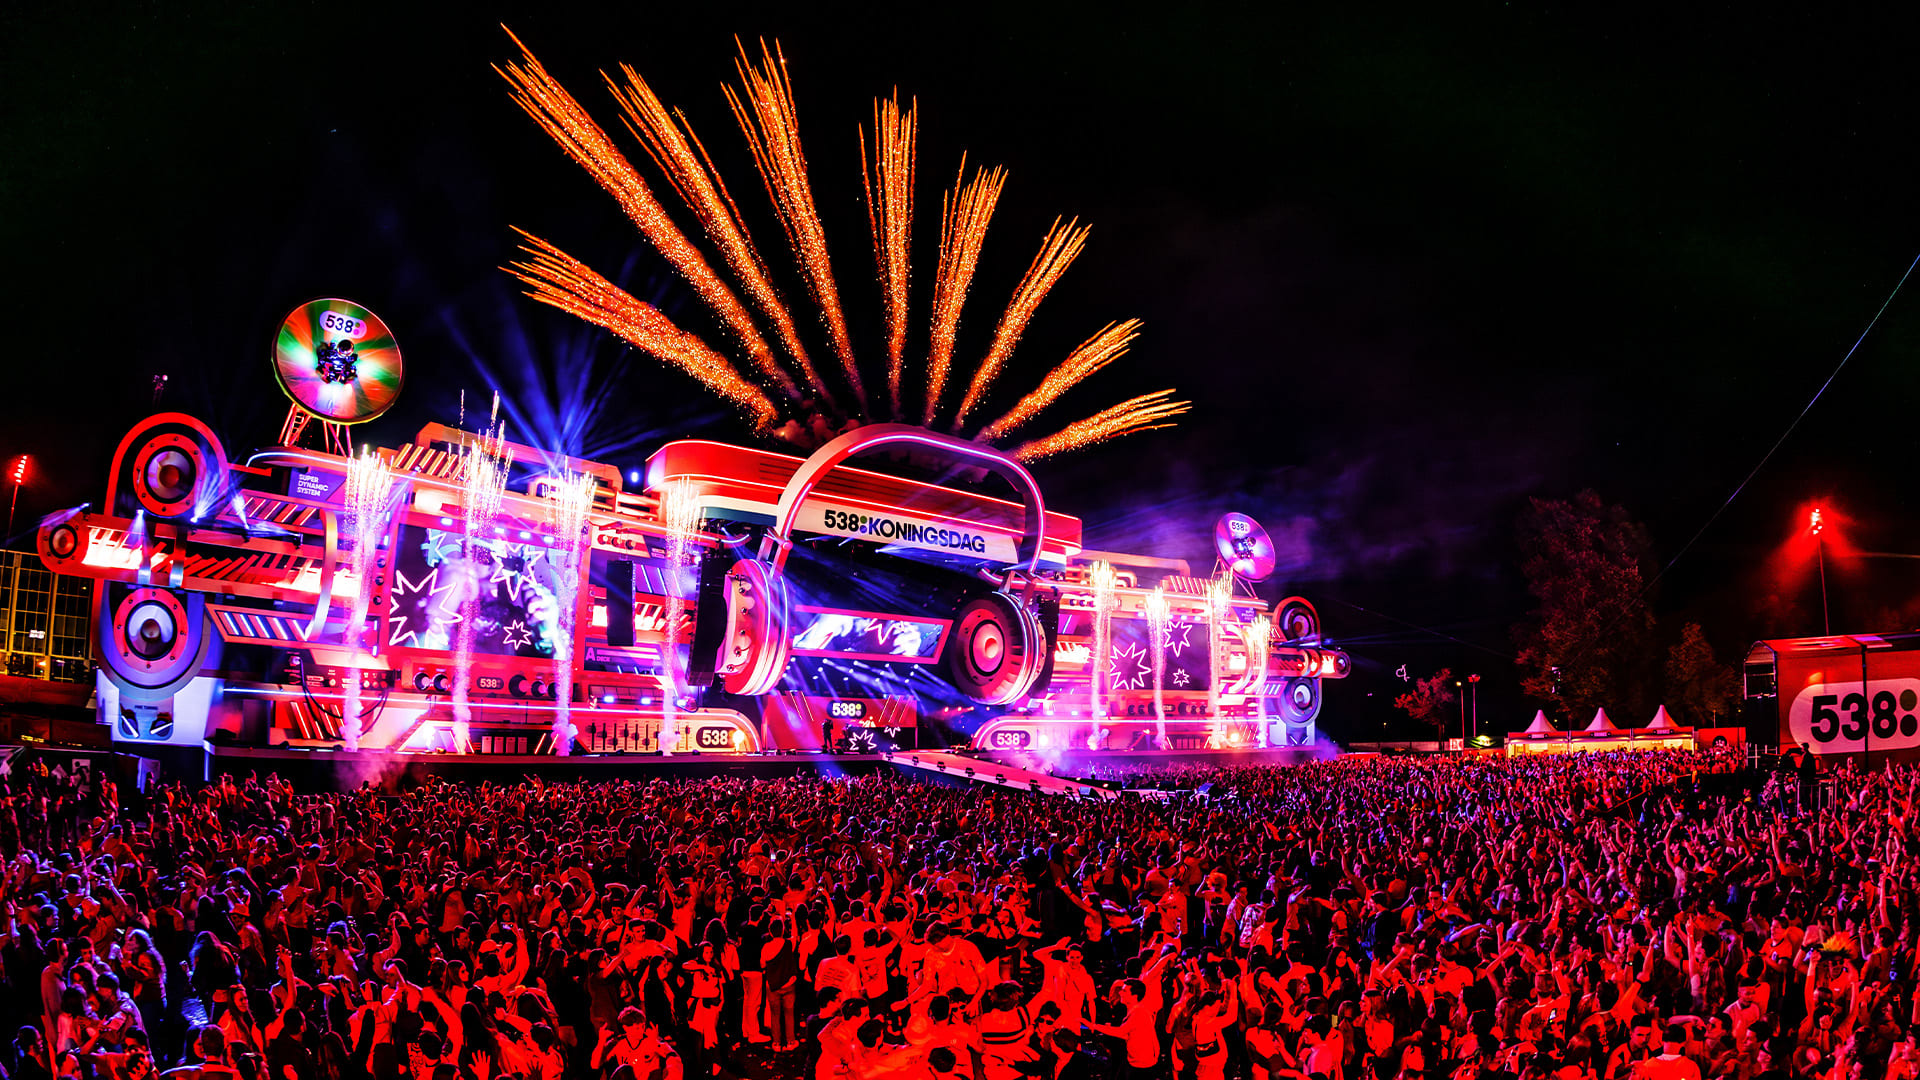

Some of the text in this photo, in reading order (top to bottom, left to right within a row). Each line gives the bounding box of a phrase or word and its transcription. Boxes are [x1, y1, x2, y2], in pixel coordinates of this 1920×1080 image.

[299, 473, 319, 483] SUPER
[296, 486, 321, 497] SYSTEM
[297, 480, 329, 492] DYNAMIC
